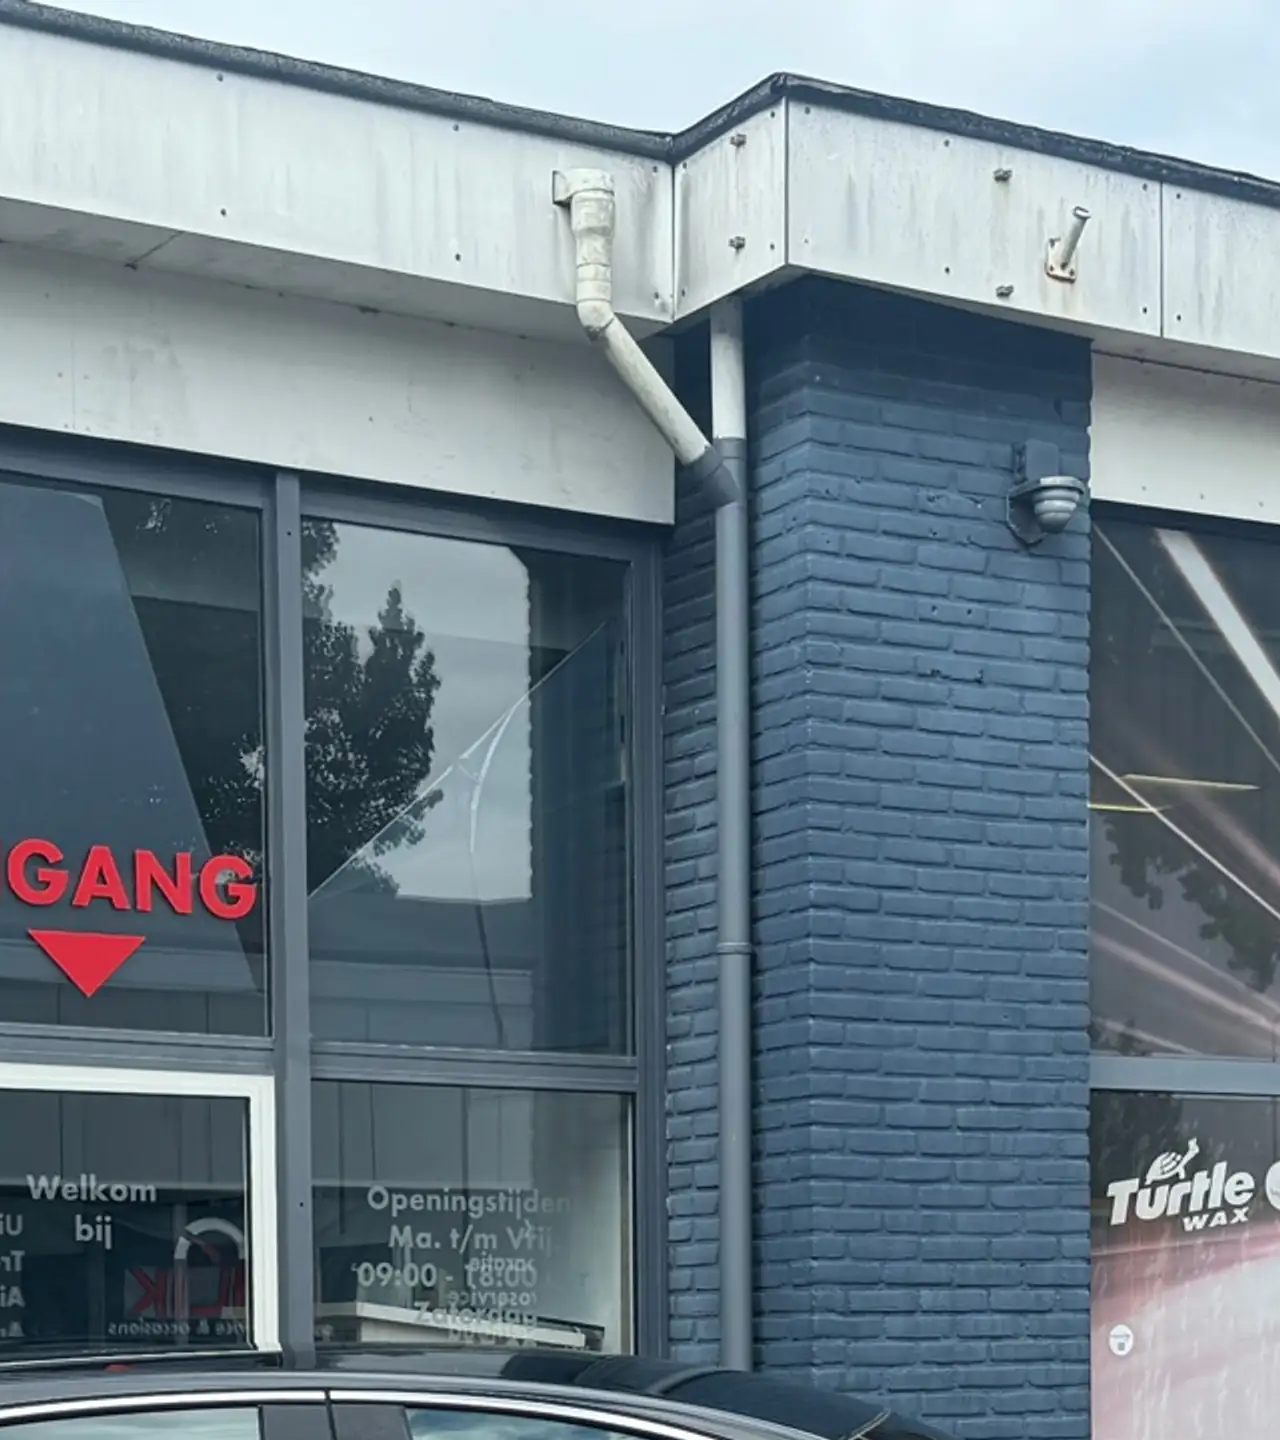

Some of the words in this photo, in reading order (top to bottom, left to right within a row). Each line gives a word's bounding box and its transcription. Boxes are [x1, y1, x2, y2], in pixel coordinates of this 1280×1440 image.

[25, 1174, 158, 1202] Welkom
[1106, 1161, 1256, 1226] Turtle
[75, 1214, 113, 1250] bij
[1182, 1206, 1251, 1232] WAX
[387, 1225, 441, 1250] Ma.
[449, 1225, 498, 1255] t/m
[355, 1261, 438, 1288] 09:00
[464, 1262, 538, 1289] 18:00
